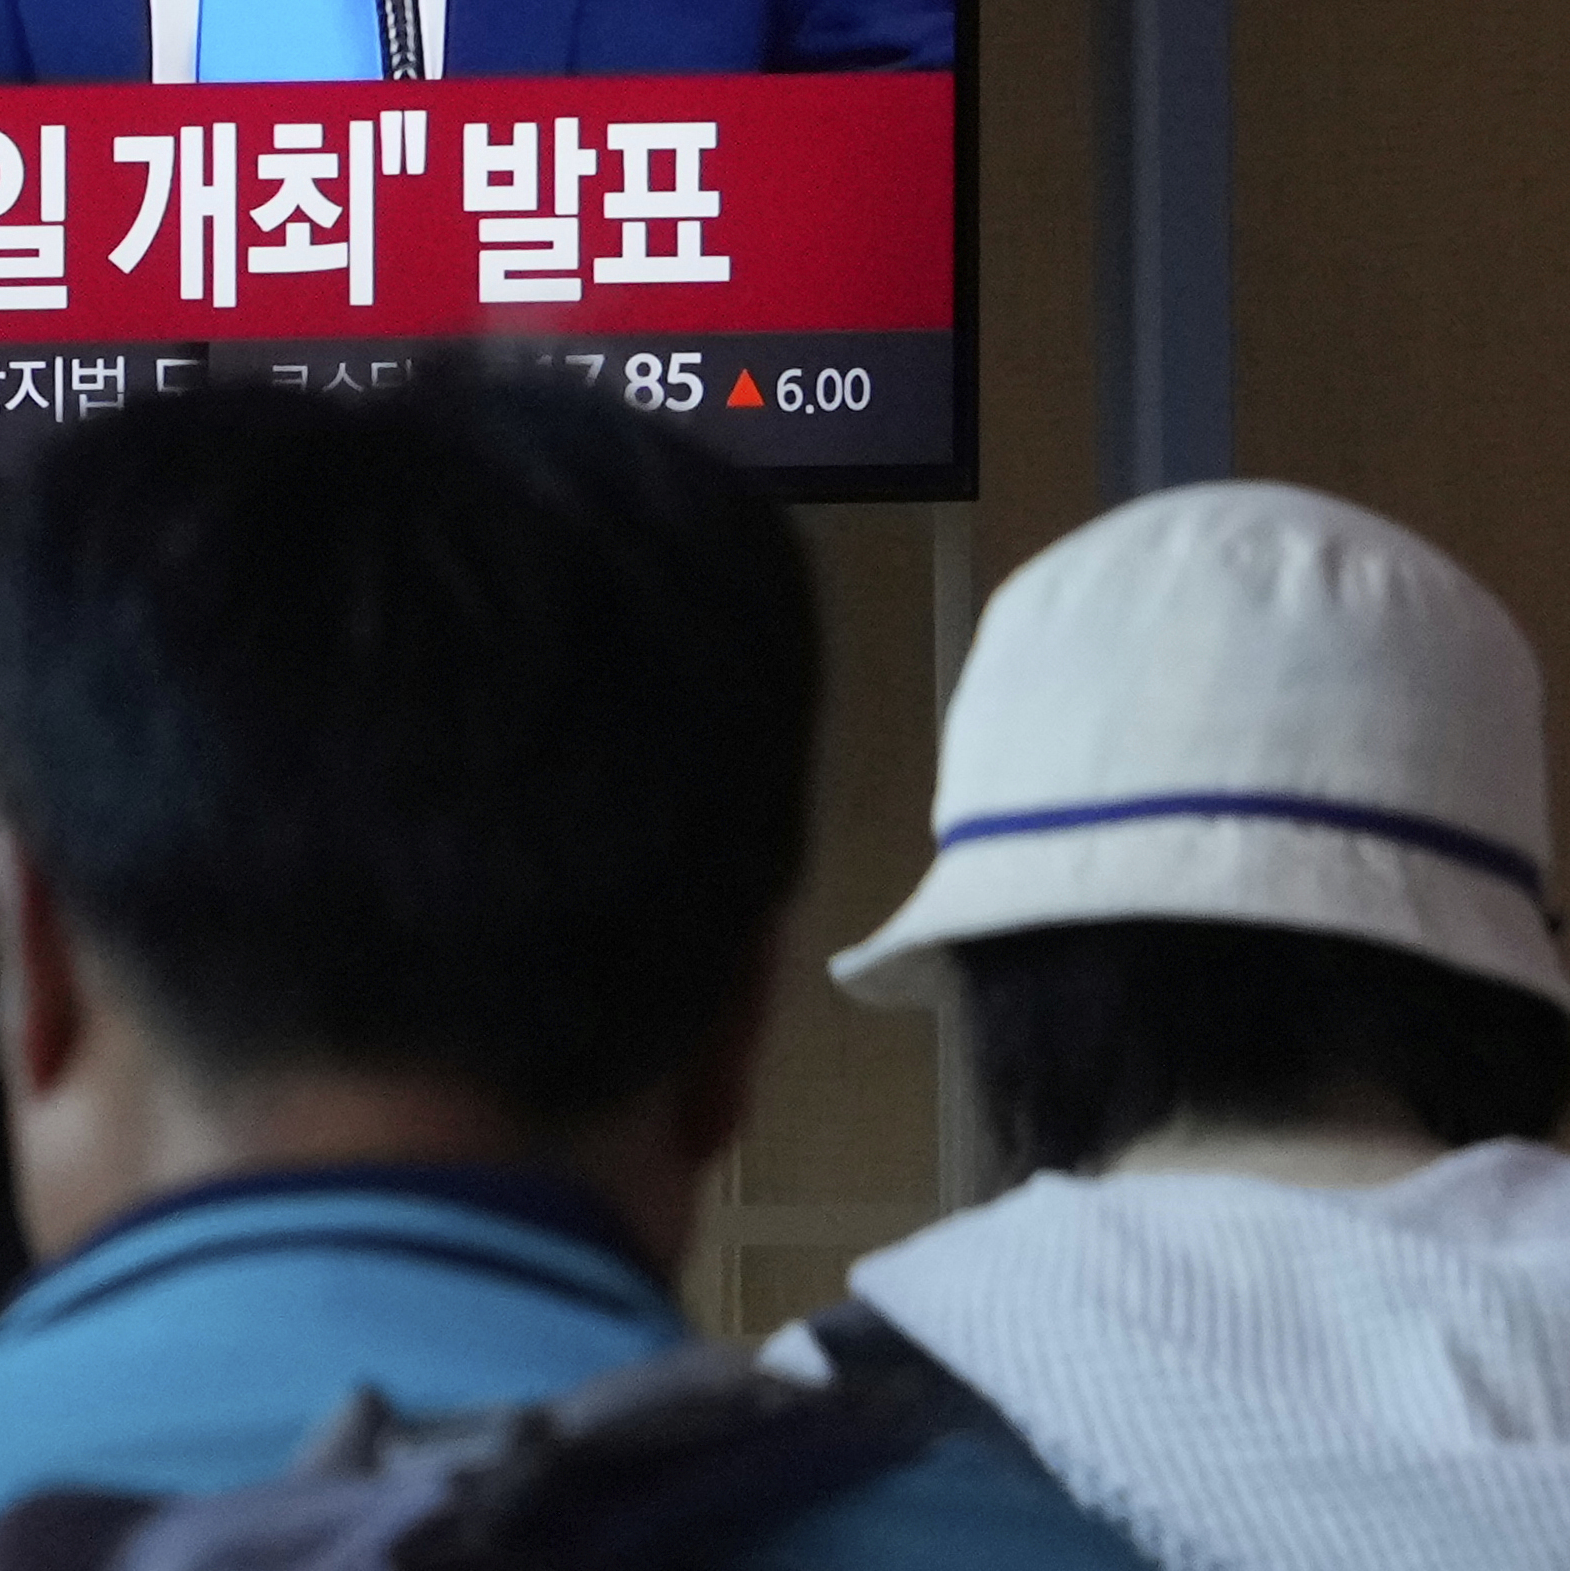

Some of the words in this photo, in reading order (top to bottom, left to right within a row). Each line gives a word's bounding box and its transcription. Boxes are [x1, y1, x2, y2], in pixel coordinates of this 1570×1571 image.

[108, 110, 427, 308] 개최"
[463, 117, 730, 303] 발표
[776, 367, 871, 414] 6.00
